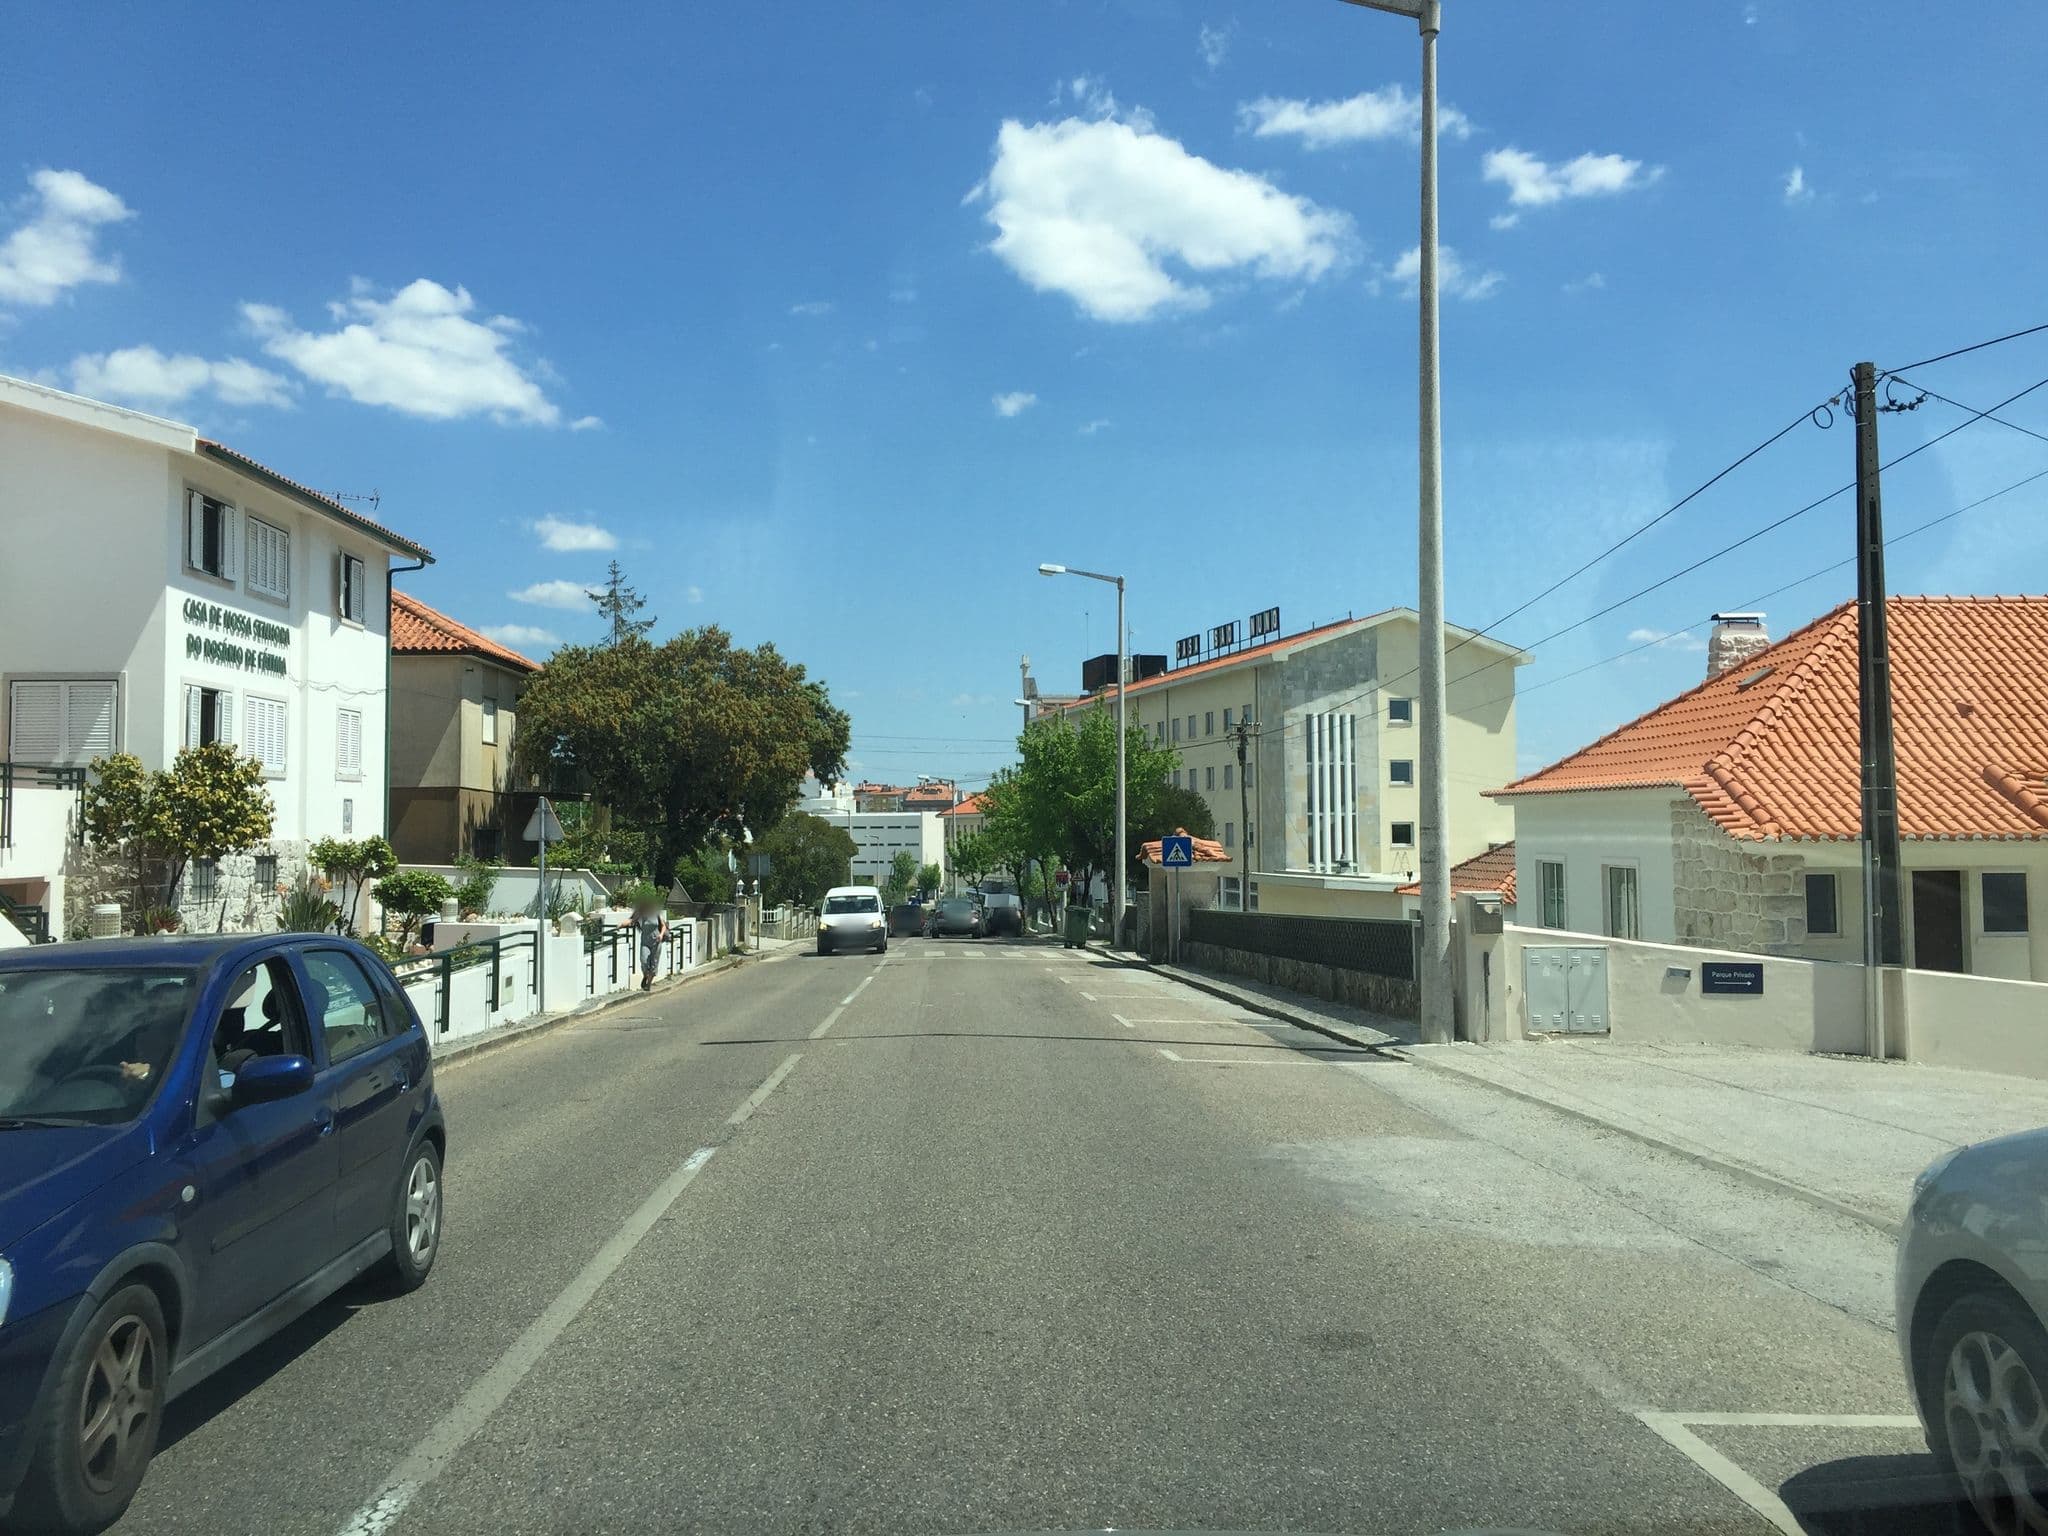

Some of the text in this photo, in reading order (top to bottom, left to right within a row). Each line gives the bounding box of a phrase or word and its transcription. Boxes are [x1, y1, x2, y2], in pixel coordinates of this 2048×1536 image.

[183, 598, 290, 645] CASA DE NOSSA SENHORA
[186, 633, 287, 675] DO ROSÁRIO DE FÁTIMA
